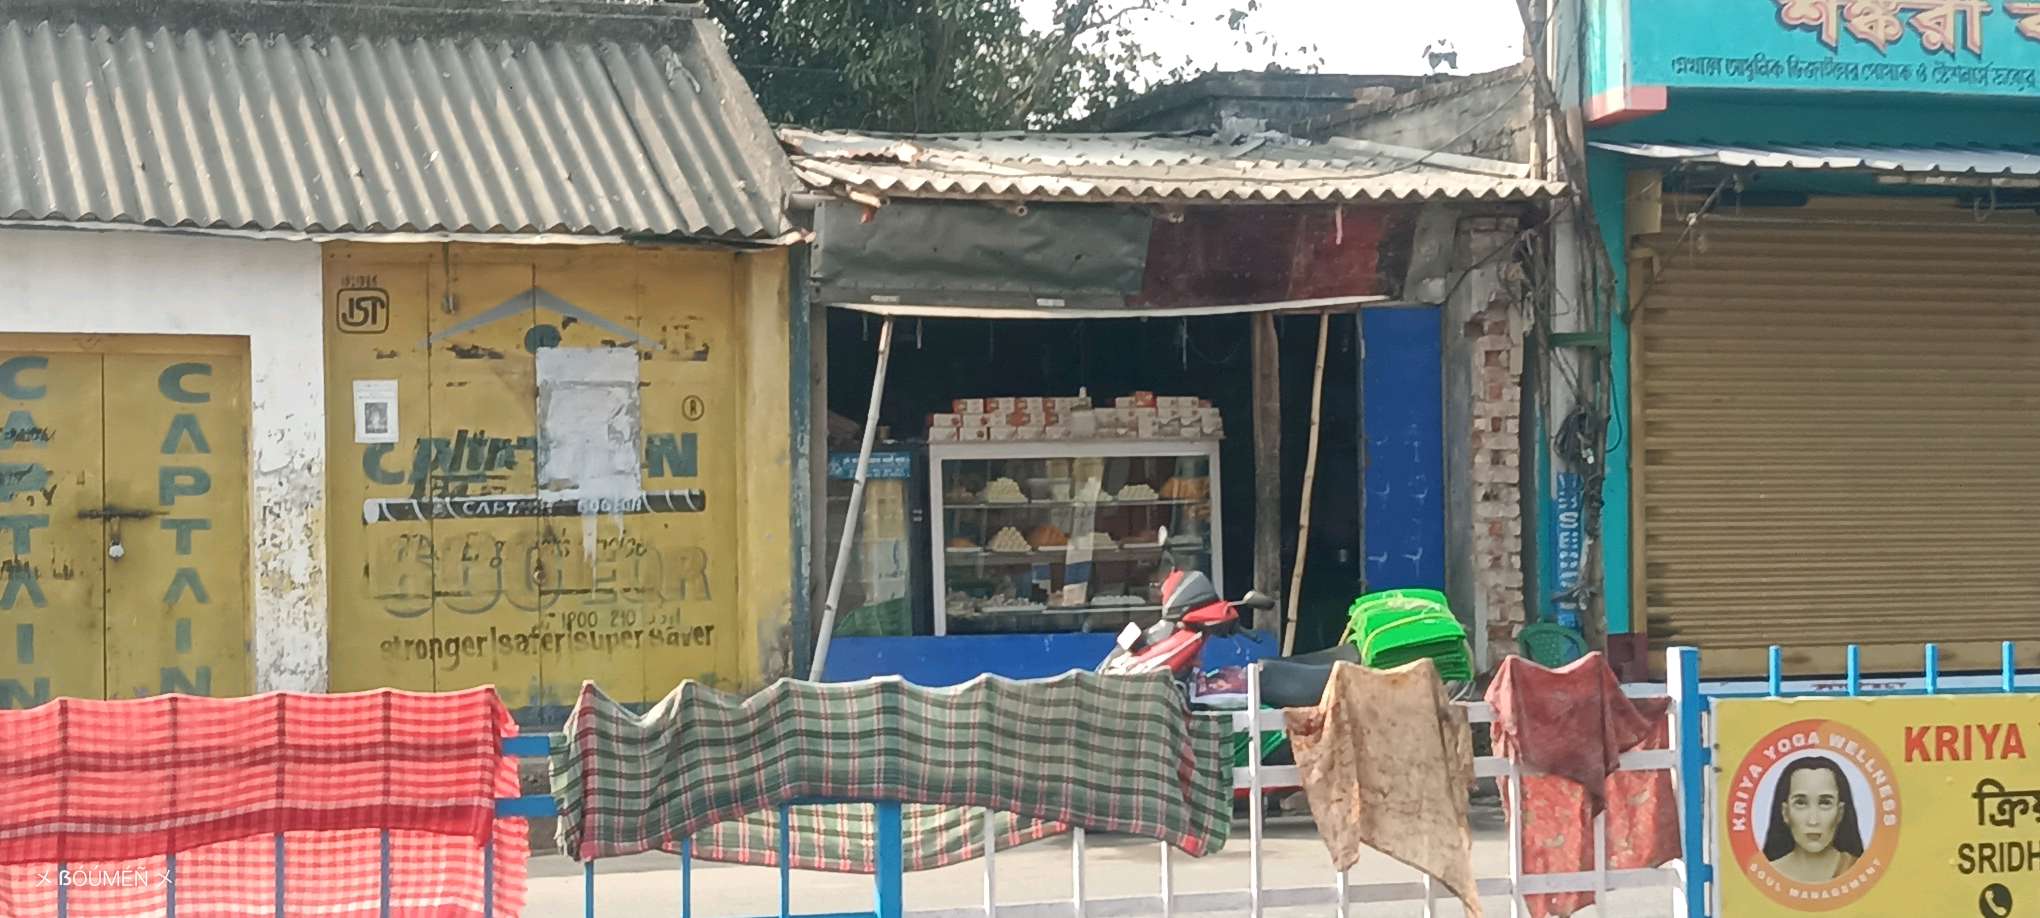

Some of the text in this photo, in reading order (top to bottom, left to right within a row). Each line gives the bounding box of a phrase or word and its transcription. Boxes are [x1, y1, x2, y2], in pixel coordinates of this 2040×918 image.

[1904, 723, 2027, 763] KRIYA
[1732, 731, 1897, 832] KRIYA YOGA WELLNESS
[1957, 840, 2040, 875] SRIDH
